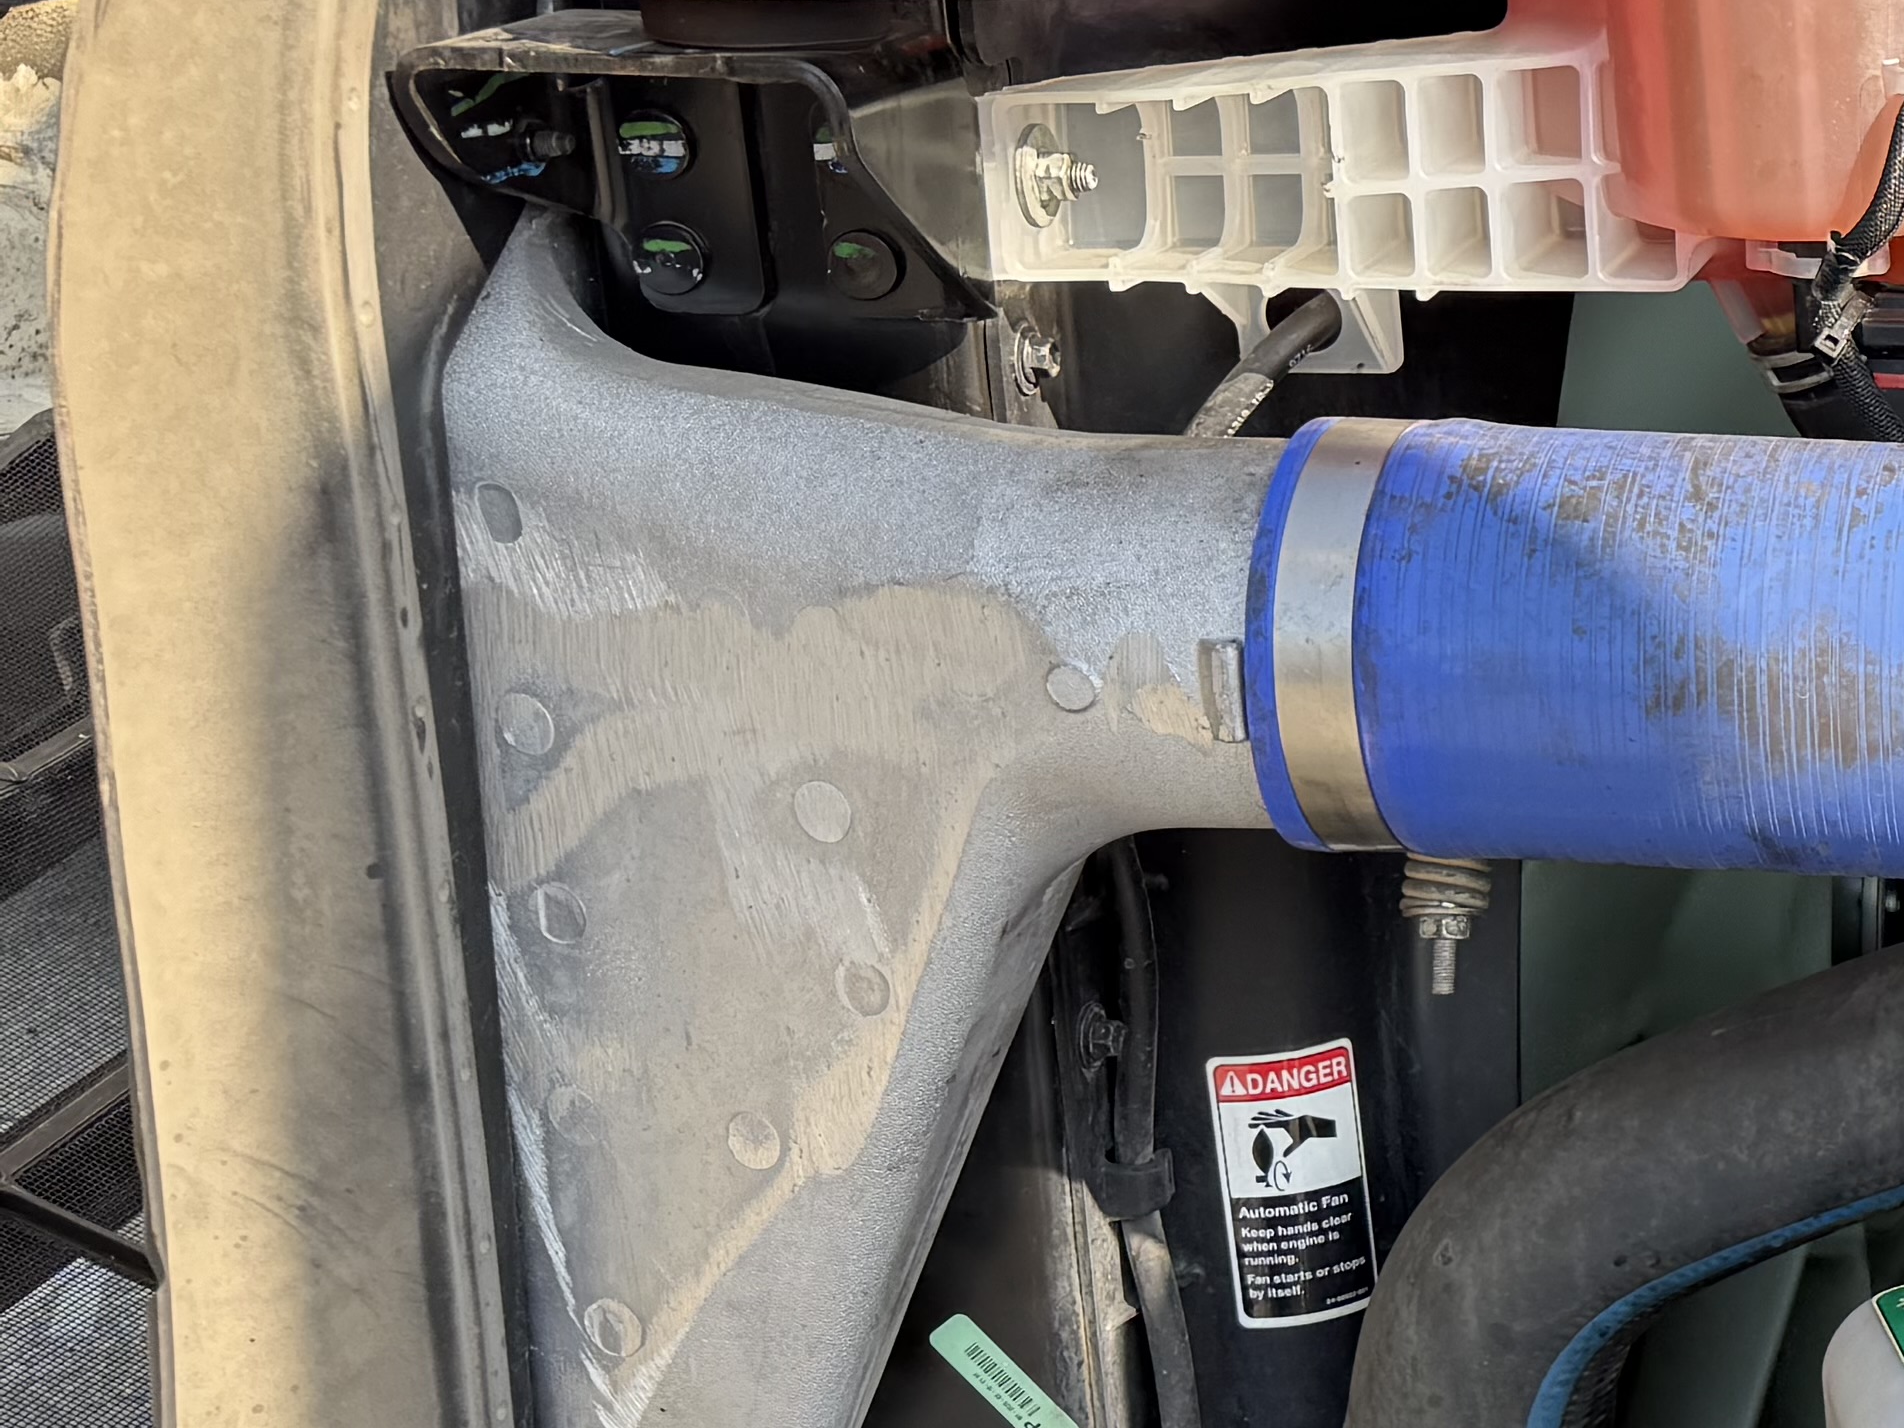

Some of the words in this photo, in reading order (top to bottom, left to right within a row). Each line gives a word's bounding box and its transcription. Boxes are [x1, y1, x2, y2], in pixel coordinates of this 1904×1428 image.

[1247, 1056, 1348, 1096] DANGER
[1238, 1199, 1318, 1219] Automatic
[1321, 1192, 1349, 1209] Fan
[1240, 1226, 1275, 1241] Keep
[1277, 1220, 1319, 1236] hands
[1321, 1212, 1353, 1229] clear
[1242, 1239, 1278, 1252] when
[1280, 1234, 1325, 1252] engine
[1328, 1230, 1340, 1242] is
[1244, 1253, 1299, 1266] running.
[1246, 1273, 1271, 1286] Fan
[1272, 1268, 1313, 1284] starts
[1315, 1266, 1330, 1279] or
[1332, 1255, 1366, 1276] stops
[1248, 1288, 1265, 1301] by
[1267, 1284, 1306, 1298] itself.
